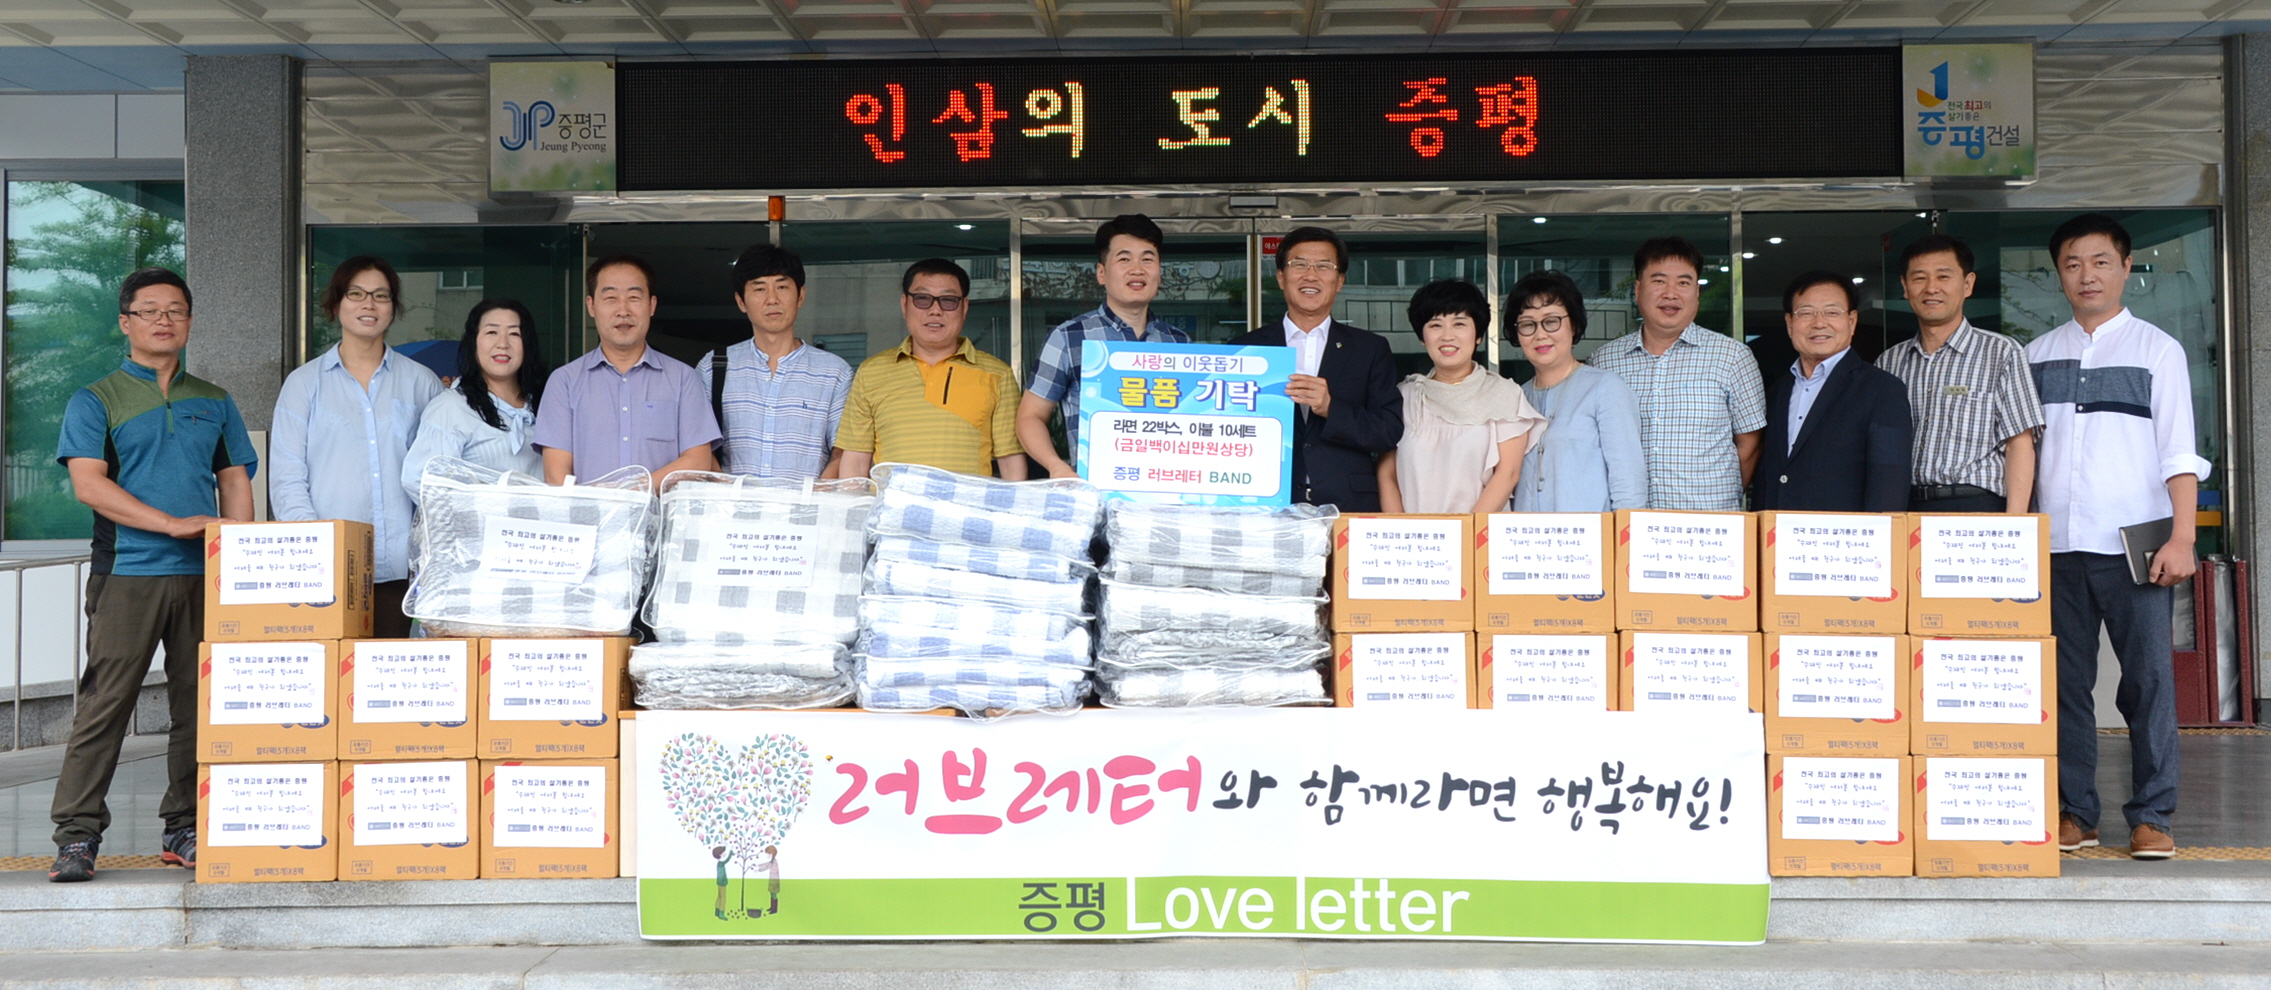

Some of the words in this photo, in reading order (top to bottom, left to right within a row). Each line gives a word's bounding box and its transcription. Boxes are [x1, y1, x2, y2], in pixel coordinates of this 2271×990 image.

[558, 113, 607, 139] 증평군
[1158, 79, 1310, 156] 도시
[1384, 76, 1538, 157] 증평
[540, 141, 569, 153] Jeung
[571, 141, 607, 153] Pyeong
[1132, 354, 1176, 370] 사랑의
[1183, 355, 1244, 373] 이웃돕기
[1118, 376, 1183, 409] 물품
[1194, 379, 1261, 412] 기탁
[1113, 419, 1138, 434] 라면
[1189, 422, 1214, 437] 이불
[1219, 424, 1257, 438] 10세트
[1114, 437, 1254, 457] (금일백이십만원상당)
[1113, 466, 1141, 481] 증평
[1147, 468, 1202, 484] 러브레터
[1209, 471, 1252, 485] BAND
[1299, 764, 1516, 826] 함께라면
[1537, 760, 1732, 835] 행복해요!
[1018, 881, 1106, 932] 증평
[1126, 877, 1274, 932] Love
[1296, 875, 1470, 933] letter
